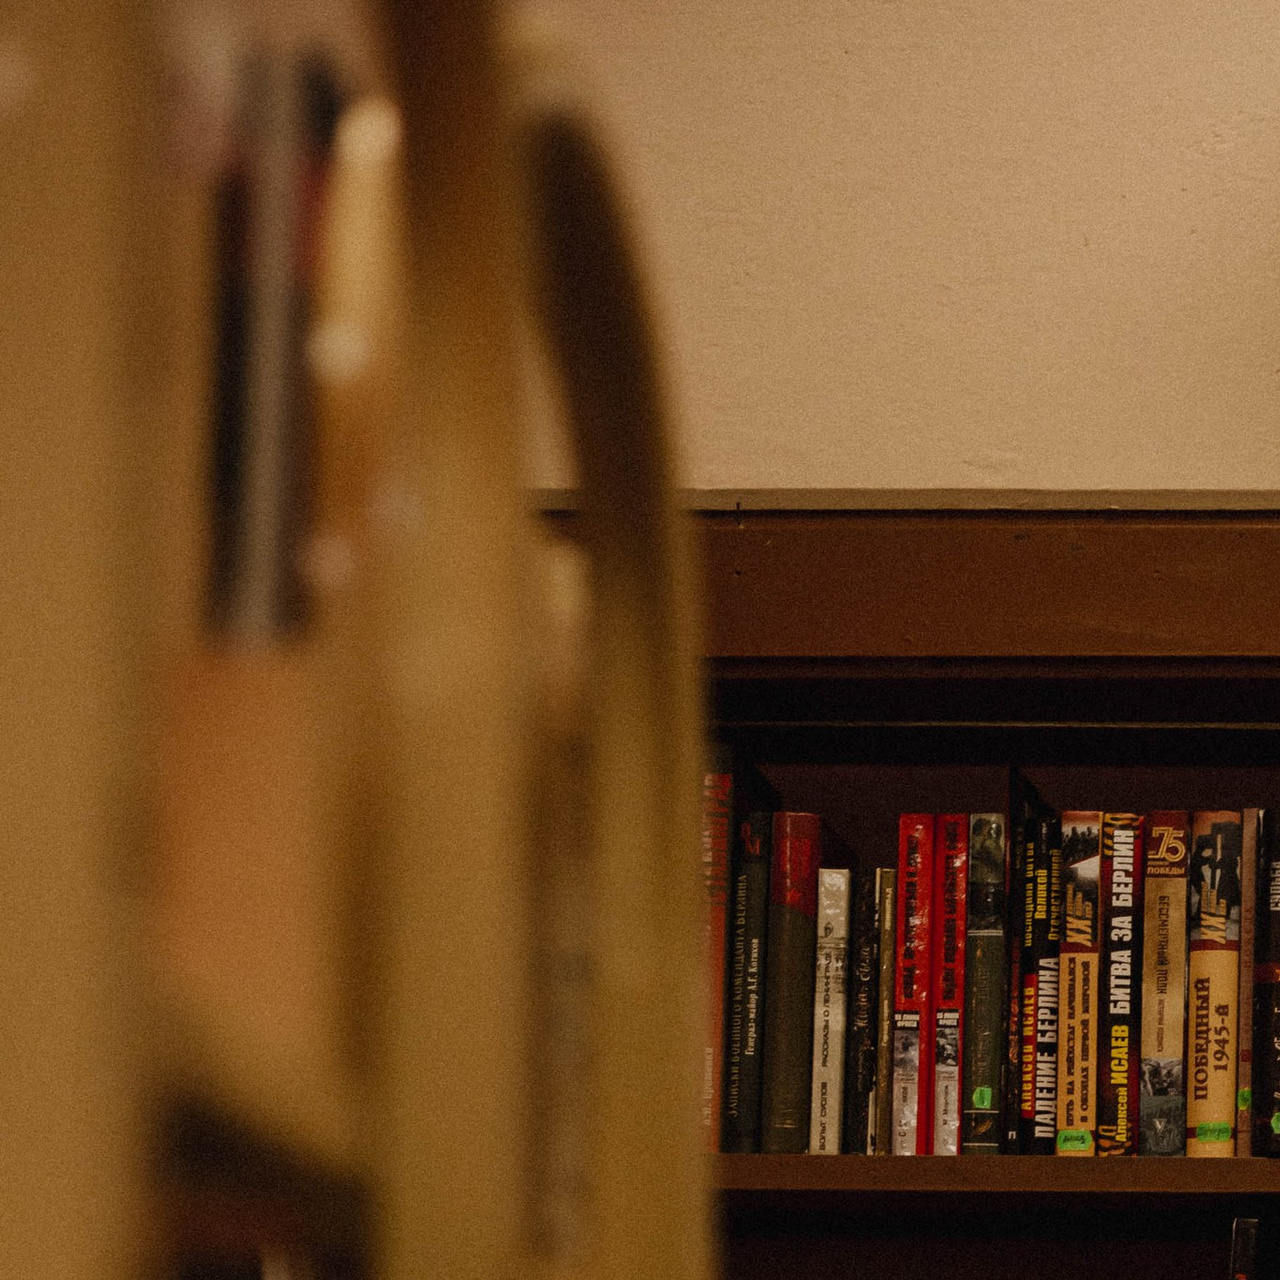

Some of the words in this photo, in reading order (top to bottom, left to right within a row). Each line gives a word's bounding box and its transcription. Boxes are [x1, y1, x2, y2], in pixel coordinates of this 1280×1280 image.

[1112, 829, 1134, 907] БЕРЛИН
[1112, 915, 1132, 941] ЗА
[1036, 958, 1059, 1043] БЕРЛИНА
[1110, 949, 1131, 1014] БИТВА
[1111, 1025, 1129, 1084] ИСАЕВ
[1194, 977, 1210, 1100] ПОБЕДНЫЙ
[1035, 1051, 1058, 1138] ПАДЕНИЕ
